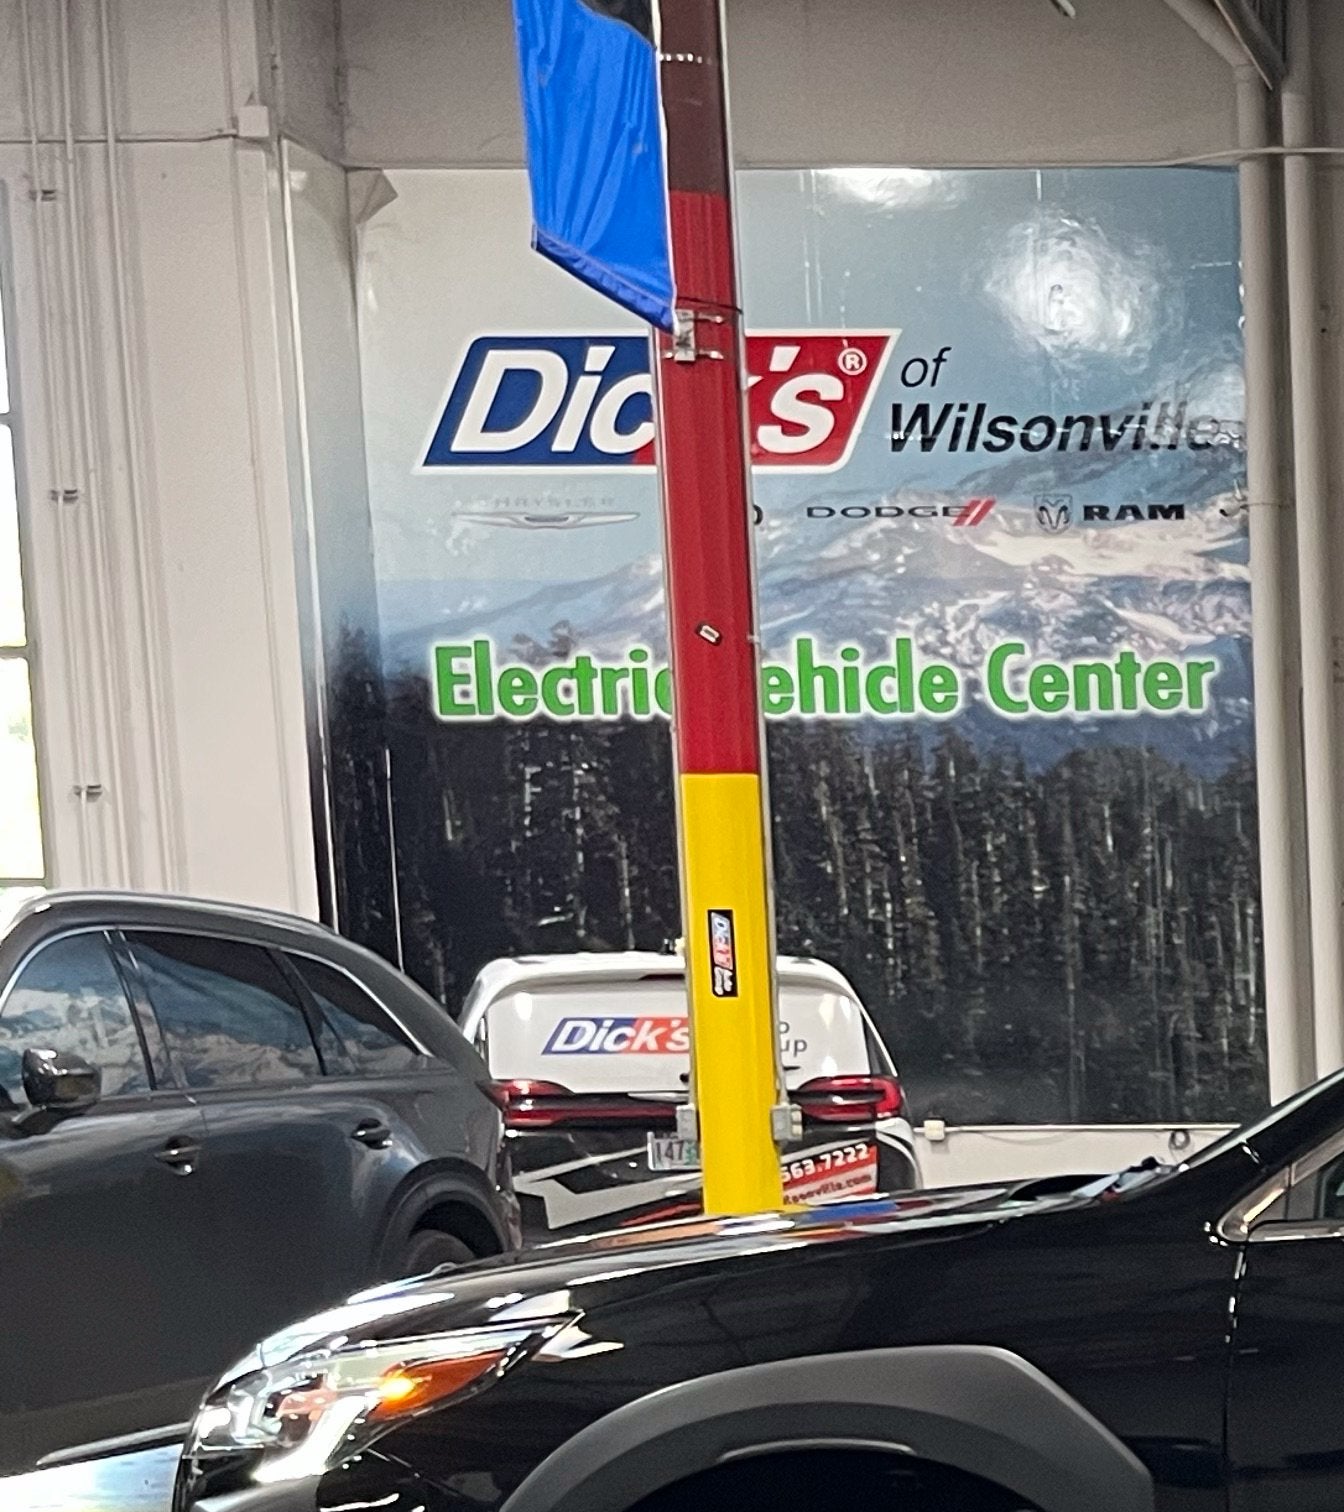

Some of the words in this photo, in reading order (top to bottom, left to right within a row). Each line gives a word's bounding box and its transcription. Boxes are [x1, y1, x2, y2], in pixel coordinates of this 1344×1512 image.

[900, 346, 952, 388] of
[806, 505, 967, 519] DODGE
[1083, 503, 1185, 521] RAM
[764, 637, 959, 714] ehicle
[987, 642, 1215, 712] Center
[551, 1019, 689, 1051] Dick's
